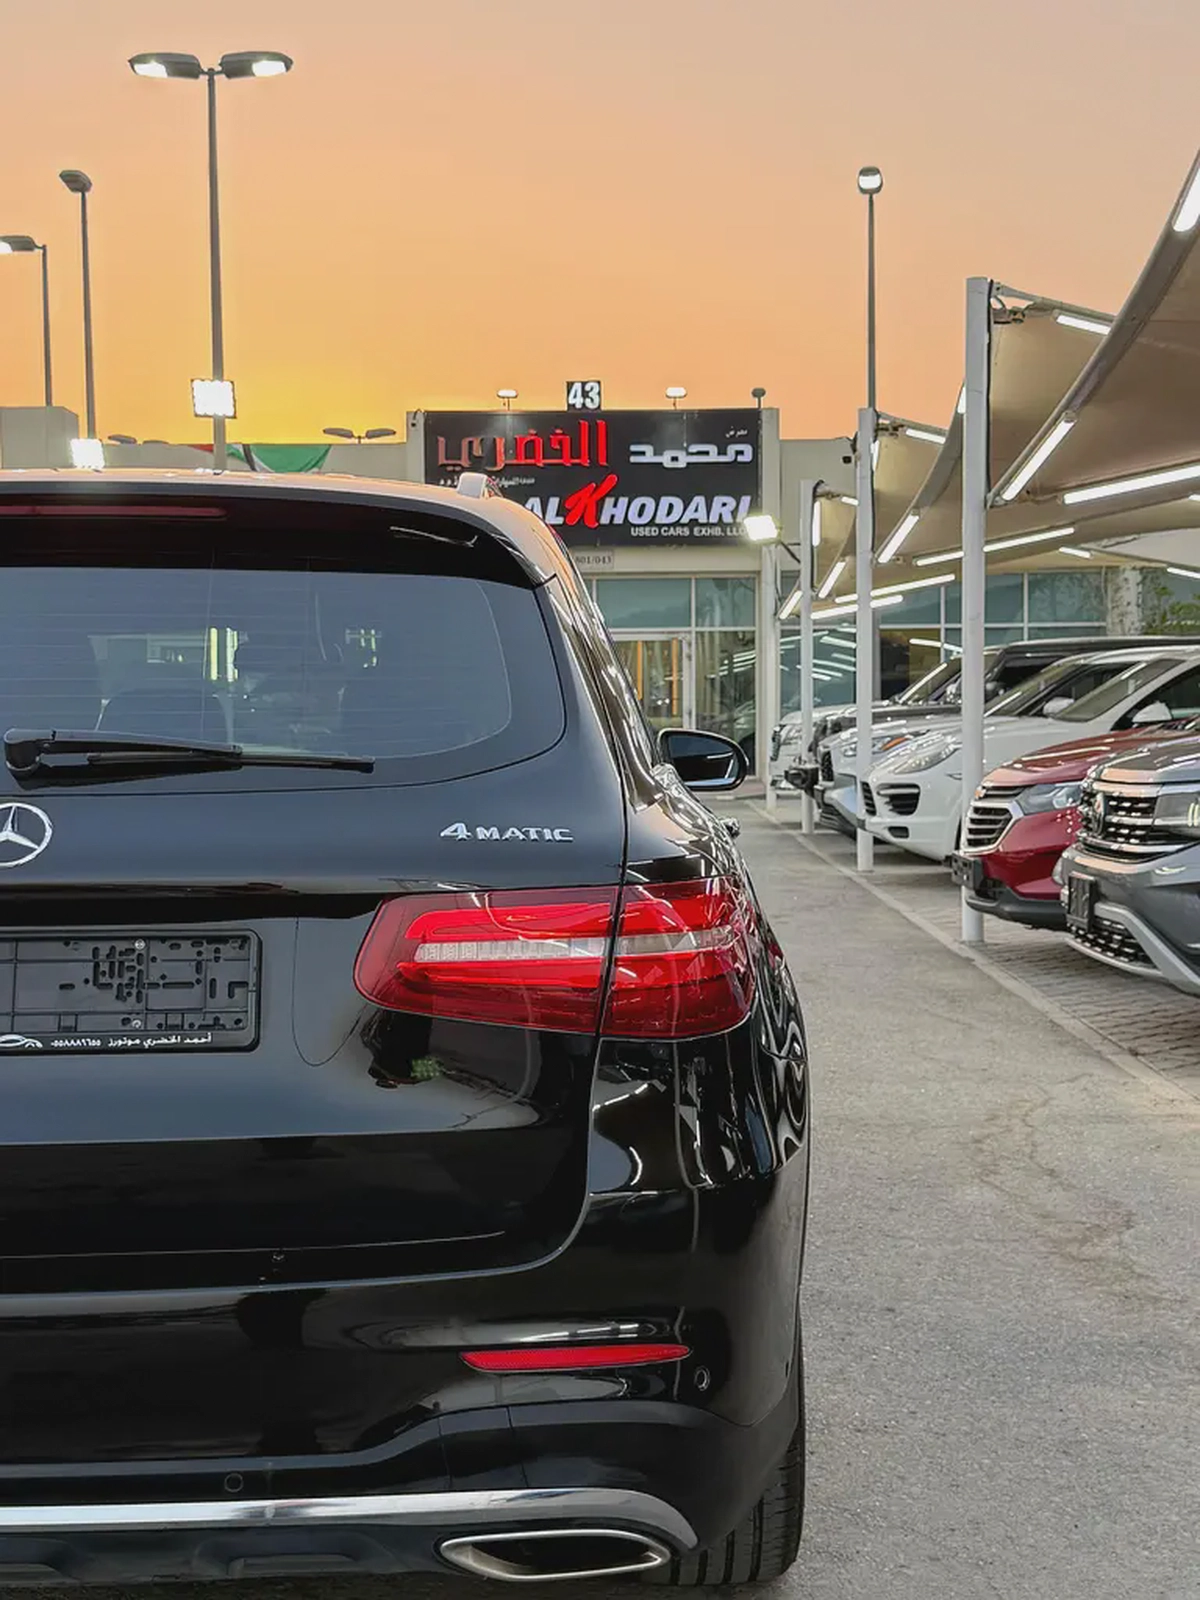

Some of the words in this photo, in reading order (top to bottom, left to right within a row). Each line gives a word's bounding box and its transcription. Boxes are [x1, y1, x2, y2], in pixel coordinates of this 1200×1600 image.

[567, 381, 601, 410] 43
[436, 419, 608, 471] الخضري
[629, 442, 754, 469] محمد
[524, 474, 751, 529] ALKHODARI
[631, 527, 660, 538] USED
[661, 527, 690, 538] CARS
[693, 526, 725, 538] EXHB.
[183, 1031, 212, 1044] أحمد
